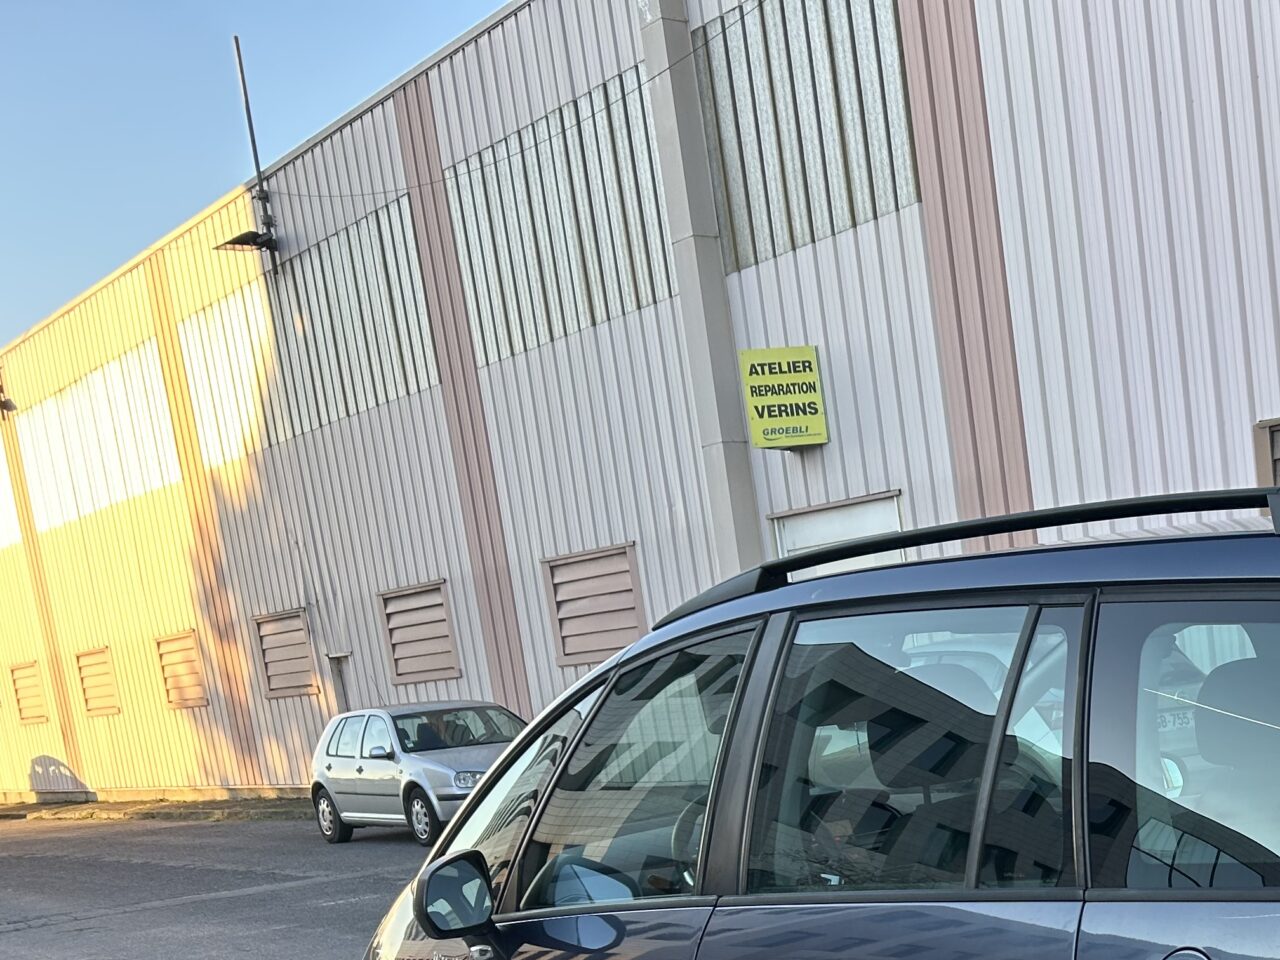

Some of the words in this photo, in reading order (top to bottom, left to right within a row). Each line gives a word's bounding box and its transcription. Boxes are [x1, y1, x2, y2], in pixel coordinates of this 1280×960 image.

[749, 360, 813, 376] ATELIER
[750, 381, 817, 397] REPARATION
[754, 401, 819, 419] VERINS
[762, 425, 809, 436] GROEBLI
